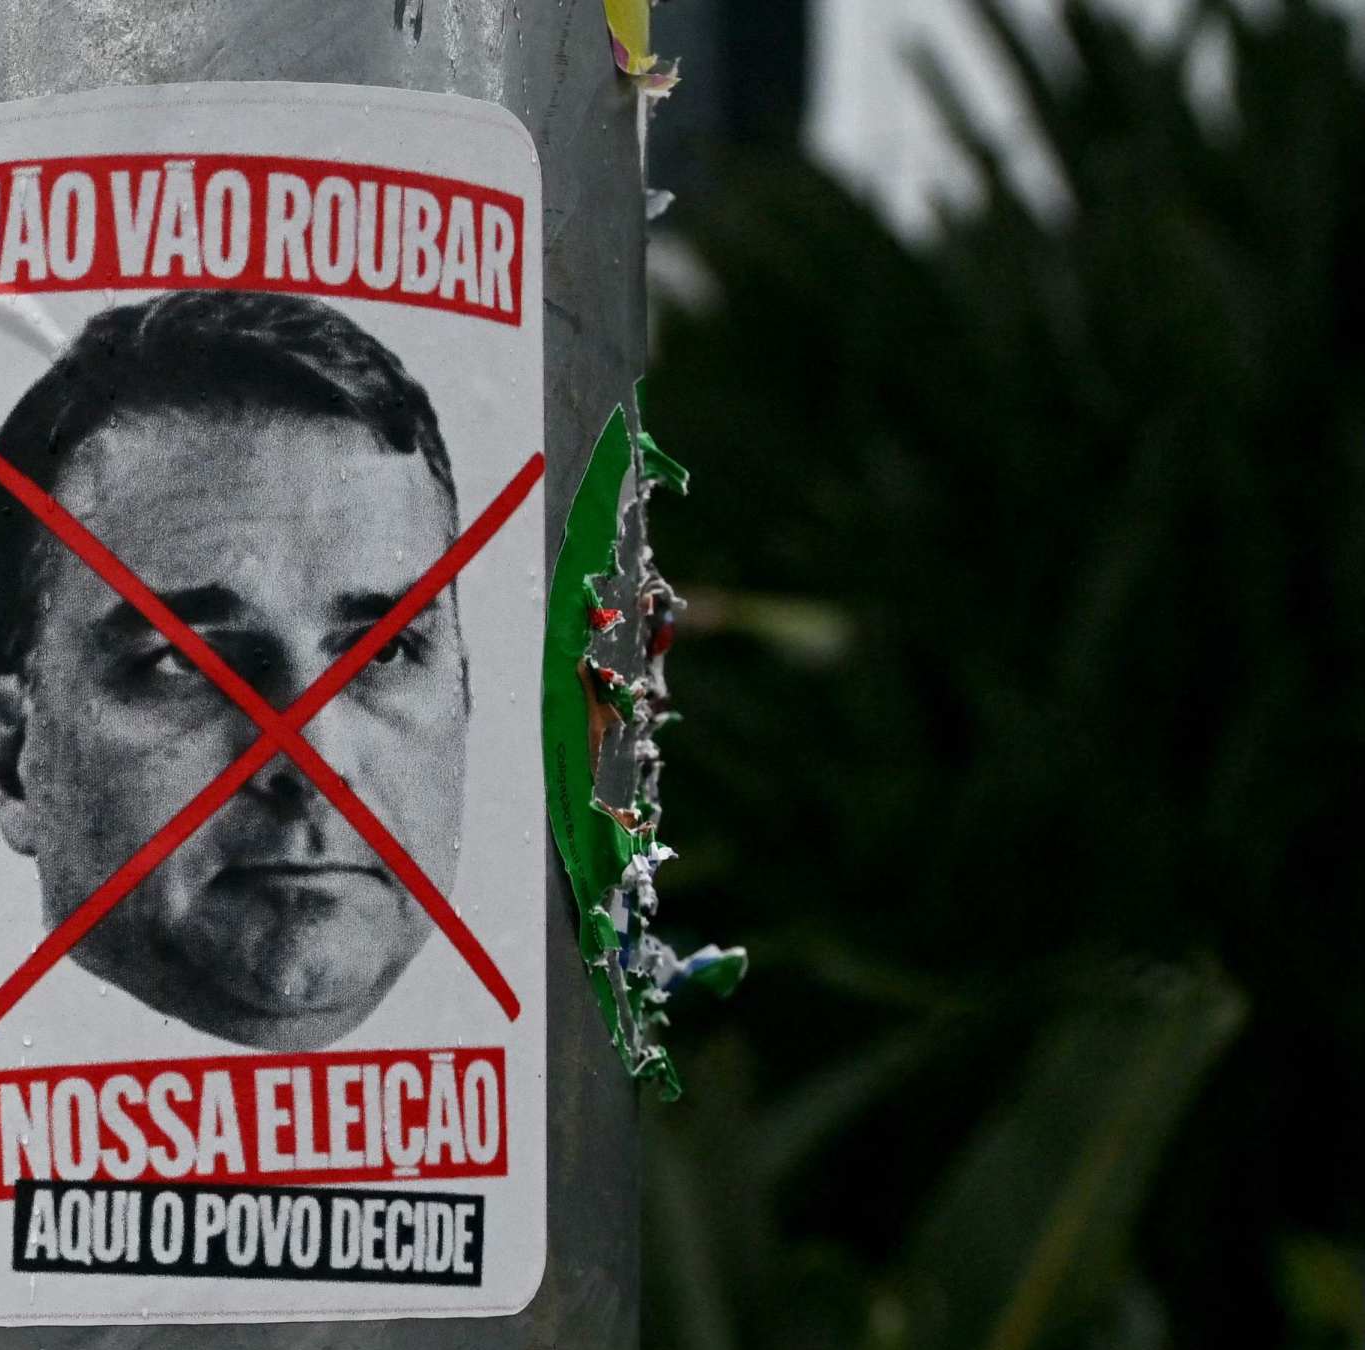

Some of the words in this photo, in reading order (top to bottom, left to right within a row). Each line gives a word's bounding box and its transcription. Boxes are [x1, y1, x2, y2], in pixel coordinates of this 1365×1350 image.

[111, 160, 252, 280] VÃO
[265, 170, 516, 312] ROUBAR
[254, 1052, 501, 1177] ELEIÇÃO
[24, 1189, 140, 1266] AQUI
[150, 1191, 187, 1265] O
[193, 1192, 323, 1270] POVO
[330, 1197, 476, 1275] DECIDE
